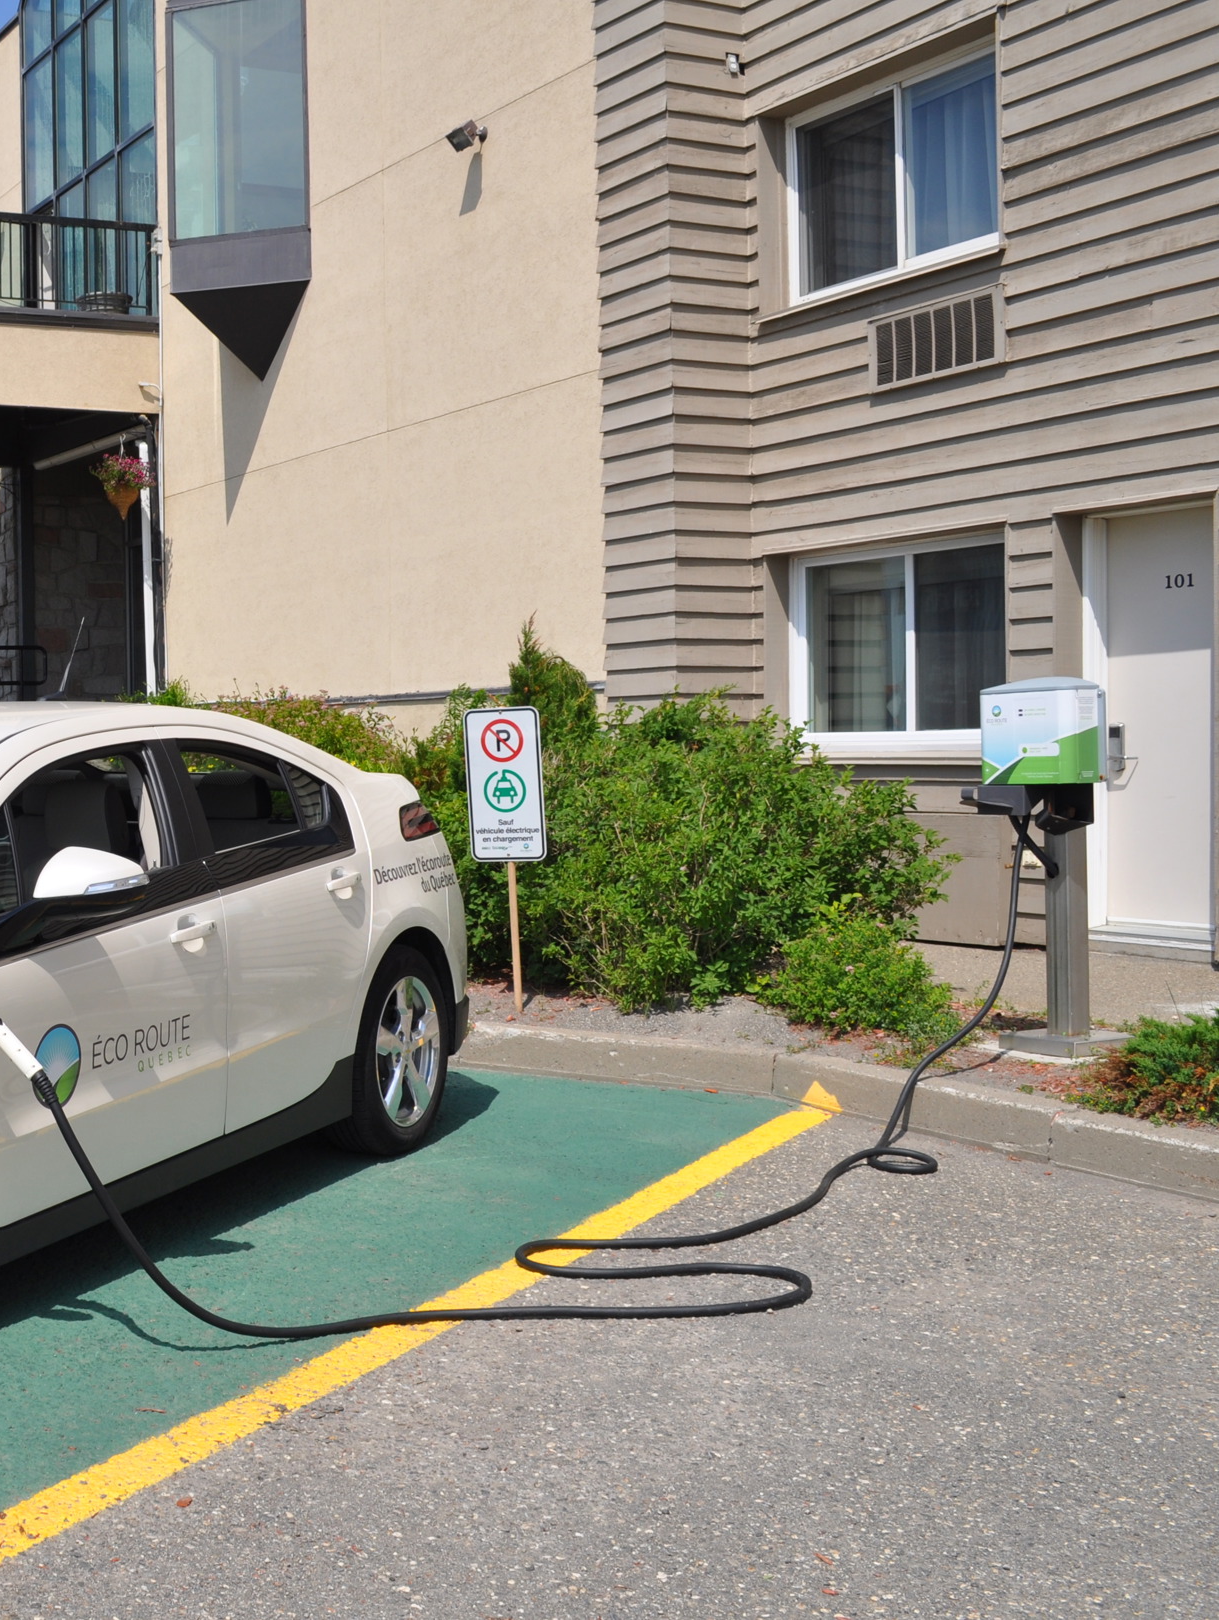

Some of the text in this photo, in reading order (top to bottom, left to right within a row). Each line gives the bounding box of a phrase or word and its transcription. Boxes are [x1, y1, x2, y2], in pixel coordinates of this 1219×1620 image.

[1165, 573, 1195, 589] 101
[498, 818, 514, 826] Sauf
[476, 826, 540, 835] véhicule électrique
[492, 835, 534, 844] chargement
[373, 853, 452, 885] Découvrez l'écoroute
[420, 871, 456, 893] du Québec
[92, 1013, 191, 1070] ÉCO ROUTE
